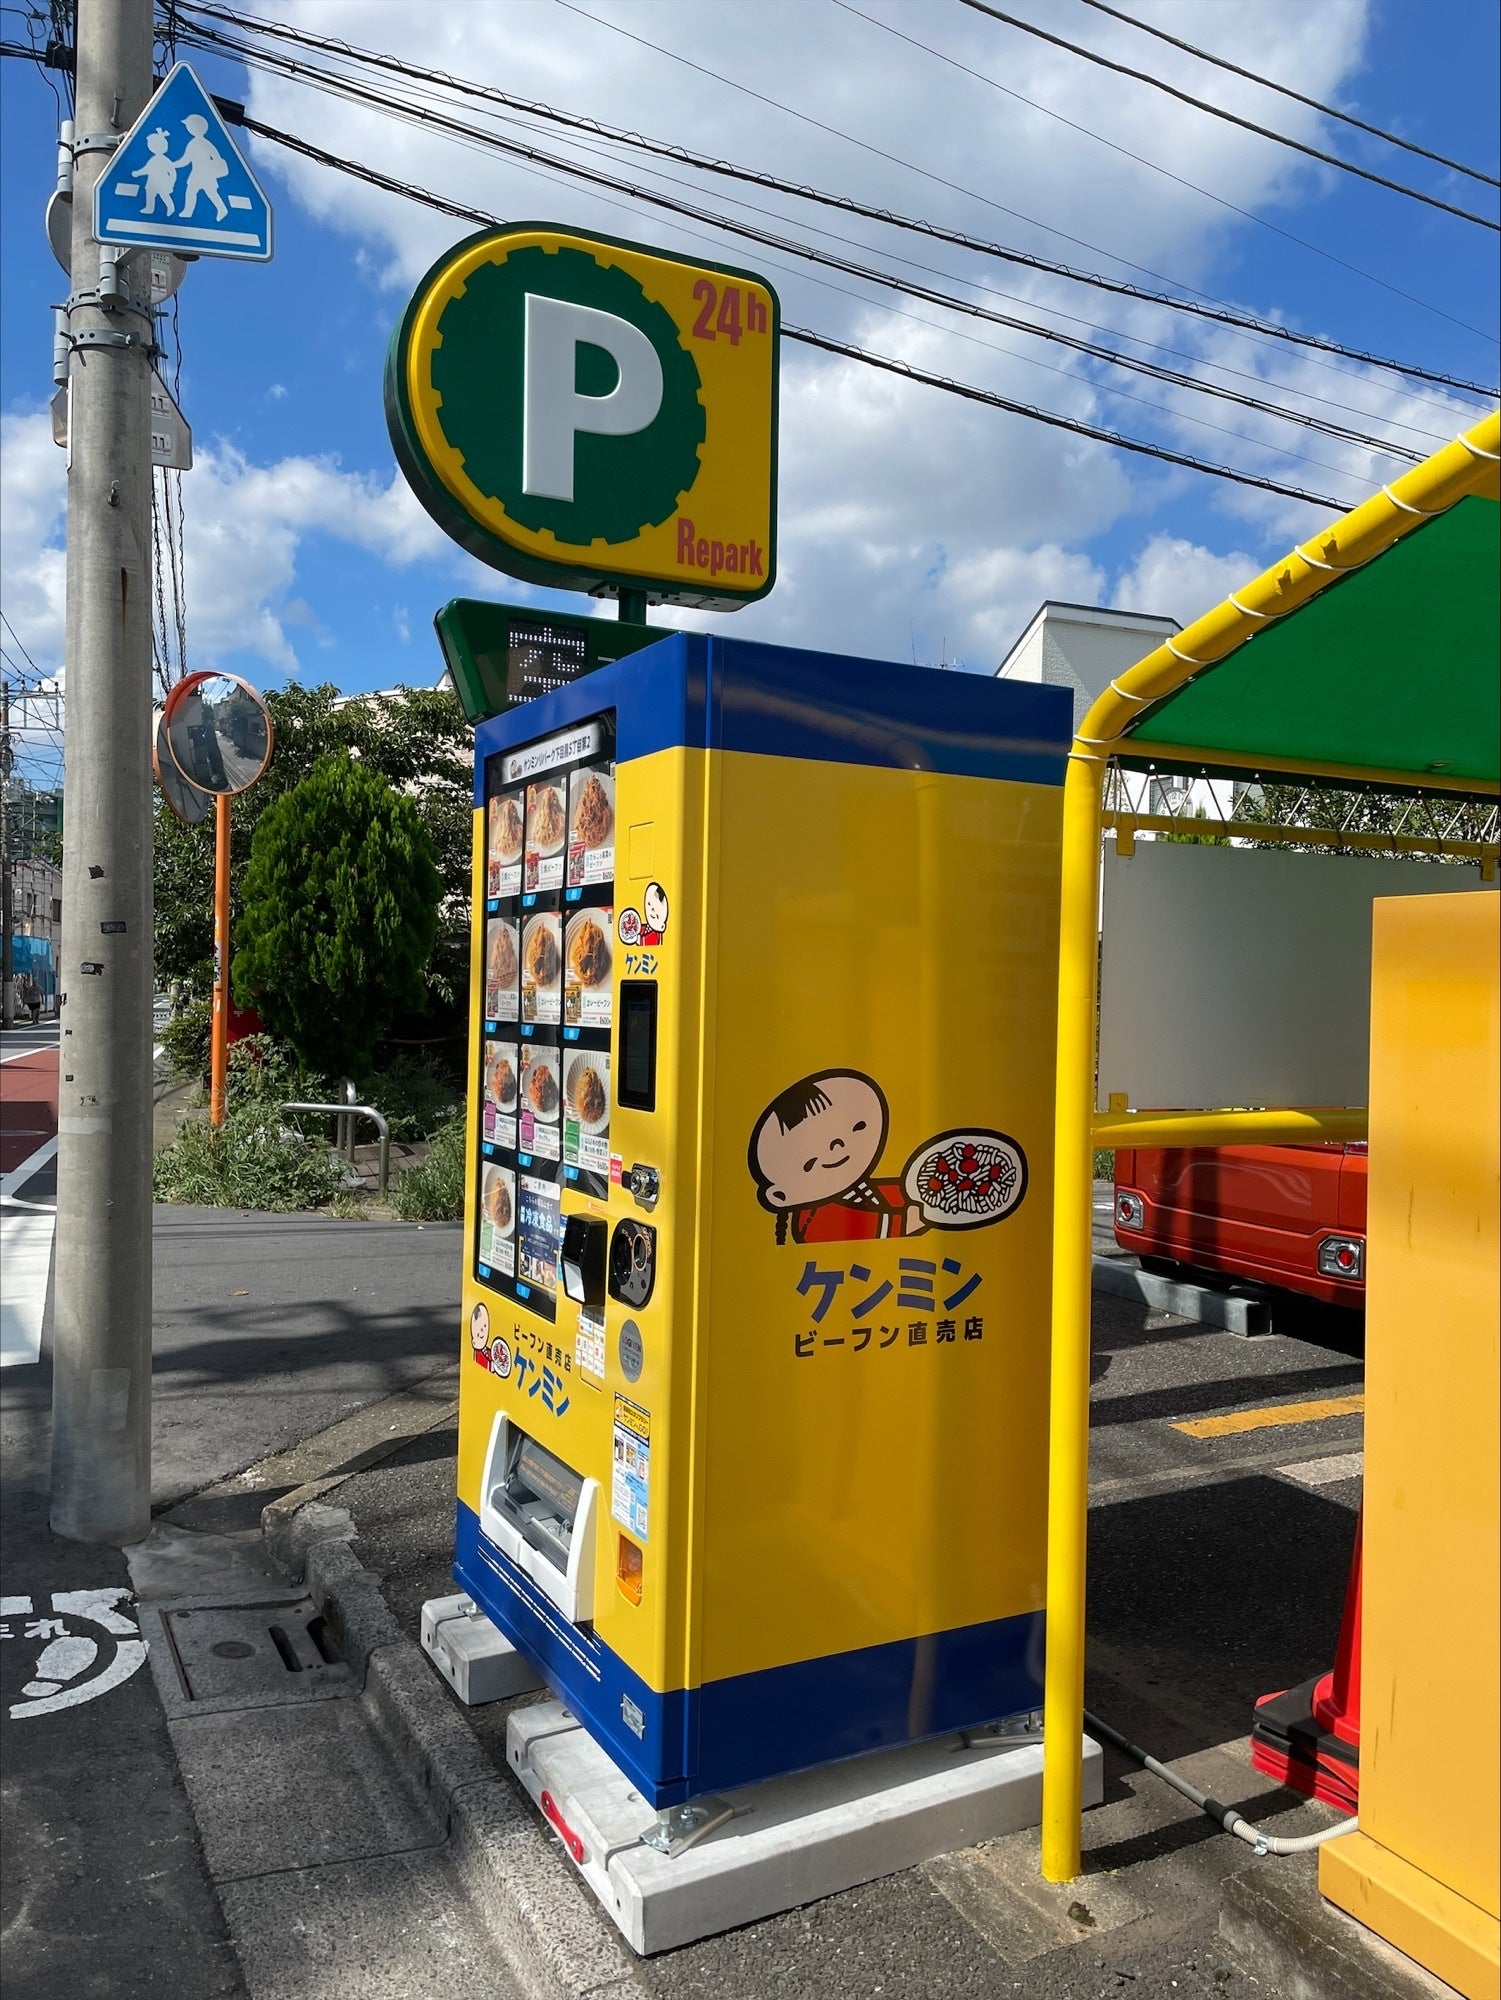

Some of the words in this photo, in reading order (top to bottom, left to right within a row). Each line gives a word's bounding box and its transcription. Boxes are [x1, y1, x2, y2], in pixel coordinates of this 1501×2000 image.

[691, 278, 767, 346] 24h
[522, 292, 663, 503] P
[677, 517, 763, 577] Repark
[509, 627, 585, 702] 空
[625, 953, 658, 975] ケンミン
[796, 1257, 983, 1325] ケンミン
[513, 1323, 572, 1373] ビーフン直売店
[794, 1316, 985, 1359] ビーフン直売店
[514, 1346, 570, 1417] ケンミン
